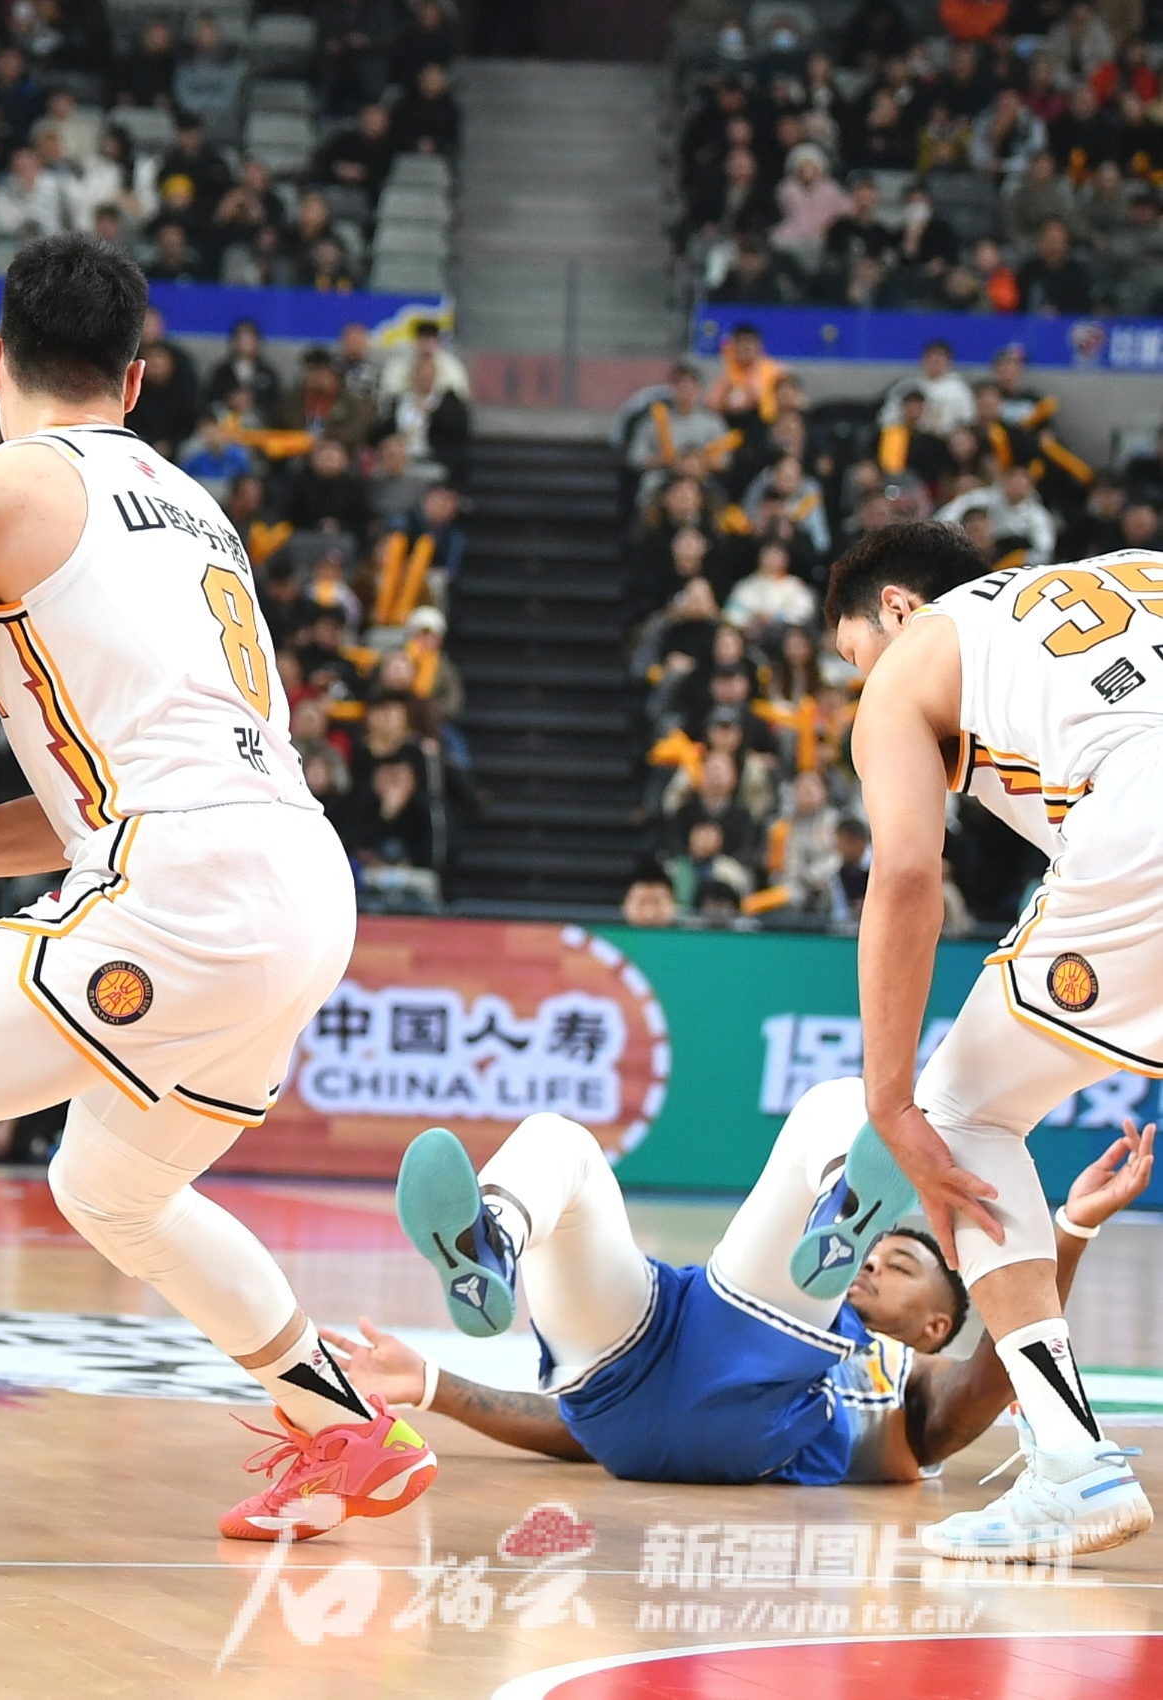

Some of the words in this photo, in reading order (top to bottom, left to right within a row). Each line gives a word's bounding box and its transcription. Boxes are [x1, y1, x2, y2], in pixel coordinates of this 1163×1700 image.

[200, 563, 271, 722] 8
[233, 727, 270, 775] 张
[88, 989, 120, 1024] SHANXI
[316, 1000, 607, 1062] 中国人寿
[313, 1068, 477, 1102] CHINA
[498, 1075, 605, 1108] LIFE
